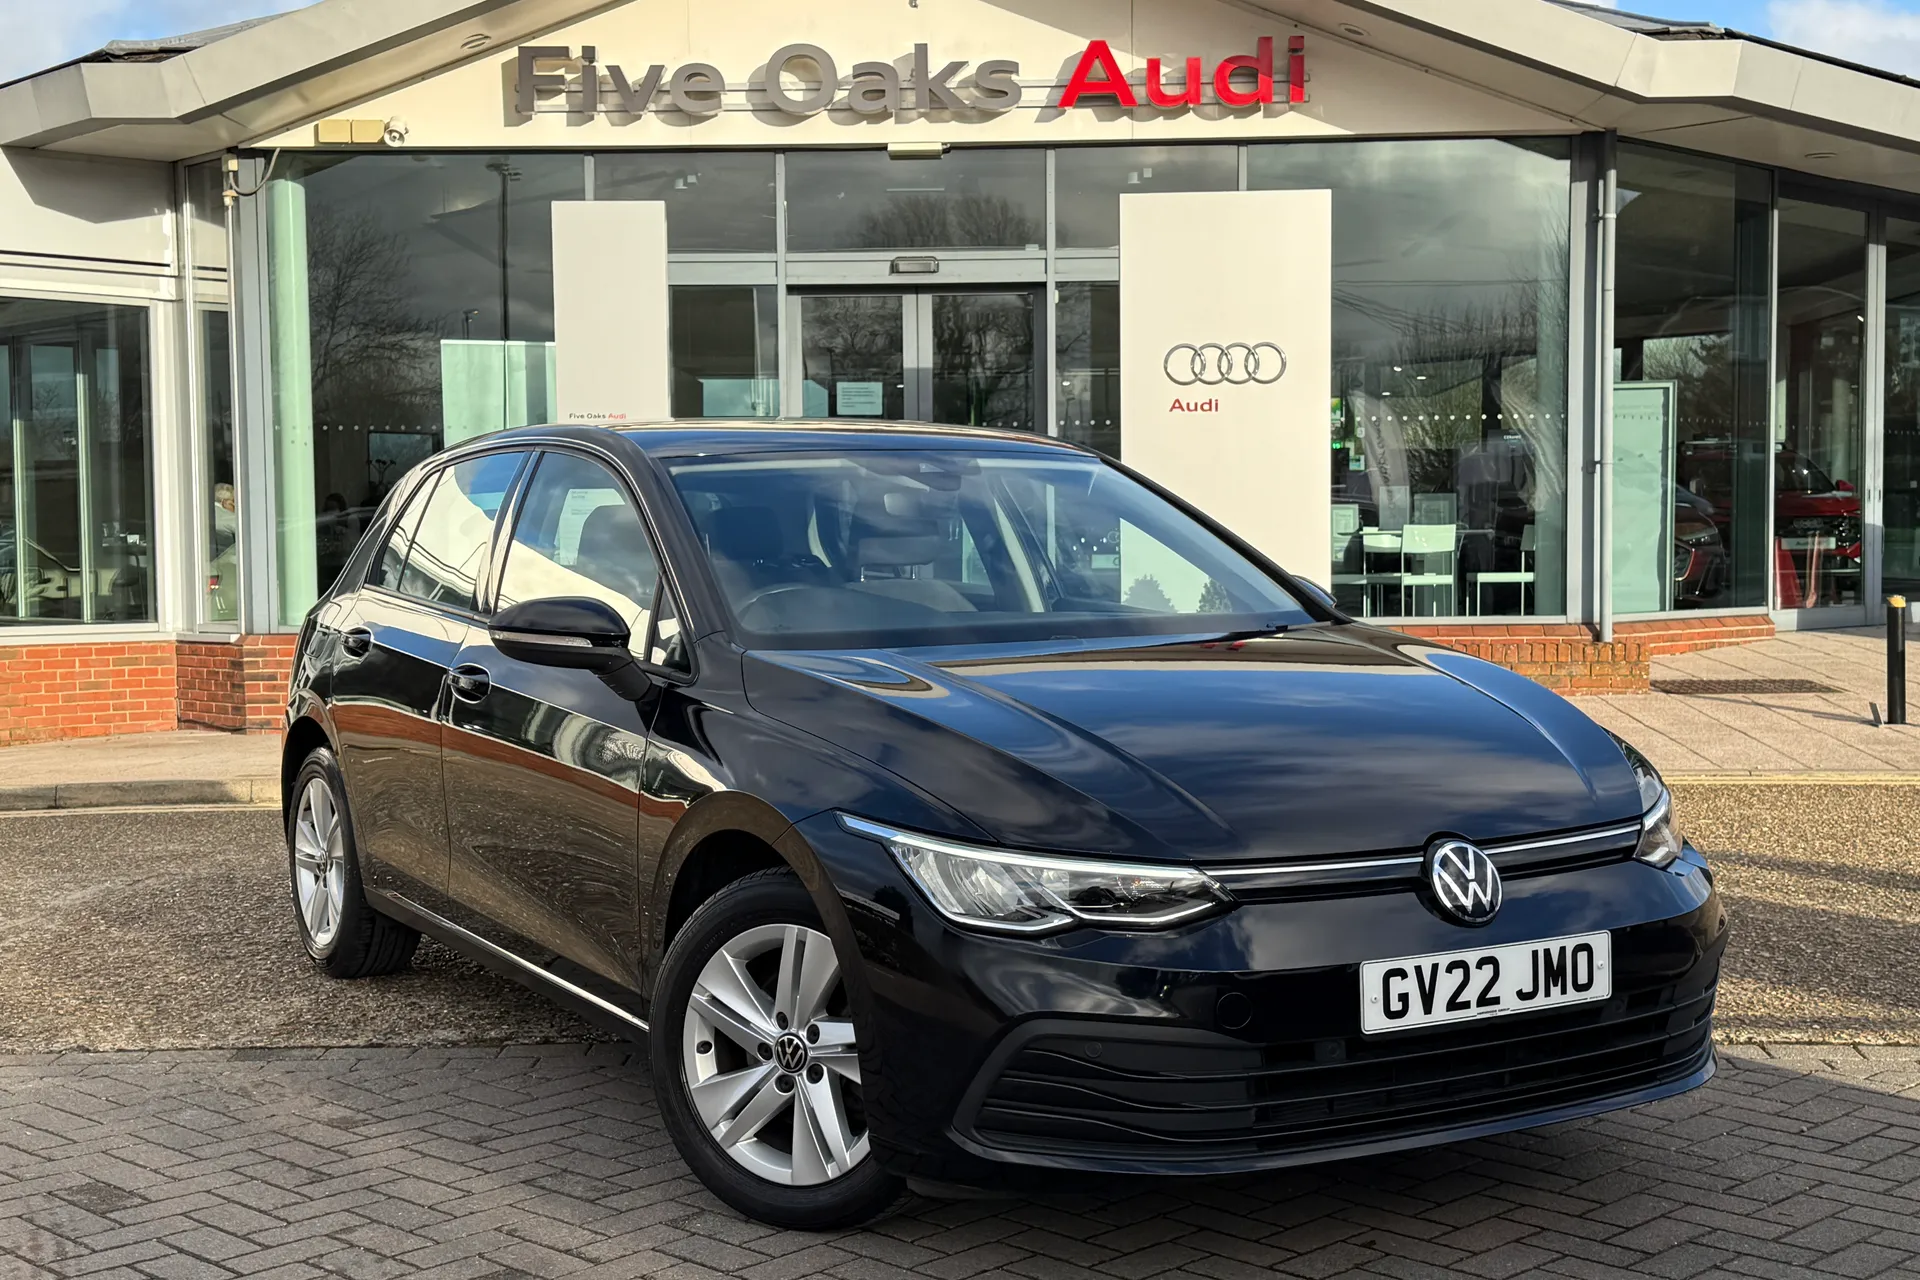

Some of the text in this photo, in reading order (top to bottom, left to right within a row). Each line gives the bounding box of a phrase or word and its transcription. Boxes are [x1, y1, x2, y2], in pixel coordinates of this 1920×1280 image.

[518, 35, 1305, 116] Five Oaks Audi
[1168, 398, 1219, 412] Audi
[1382, 942, 1594, 1021] GV22 JMO
